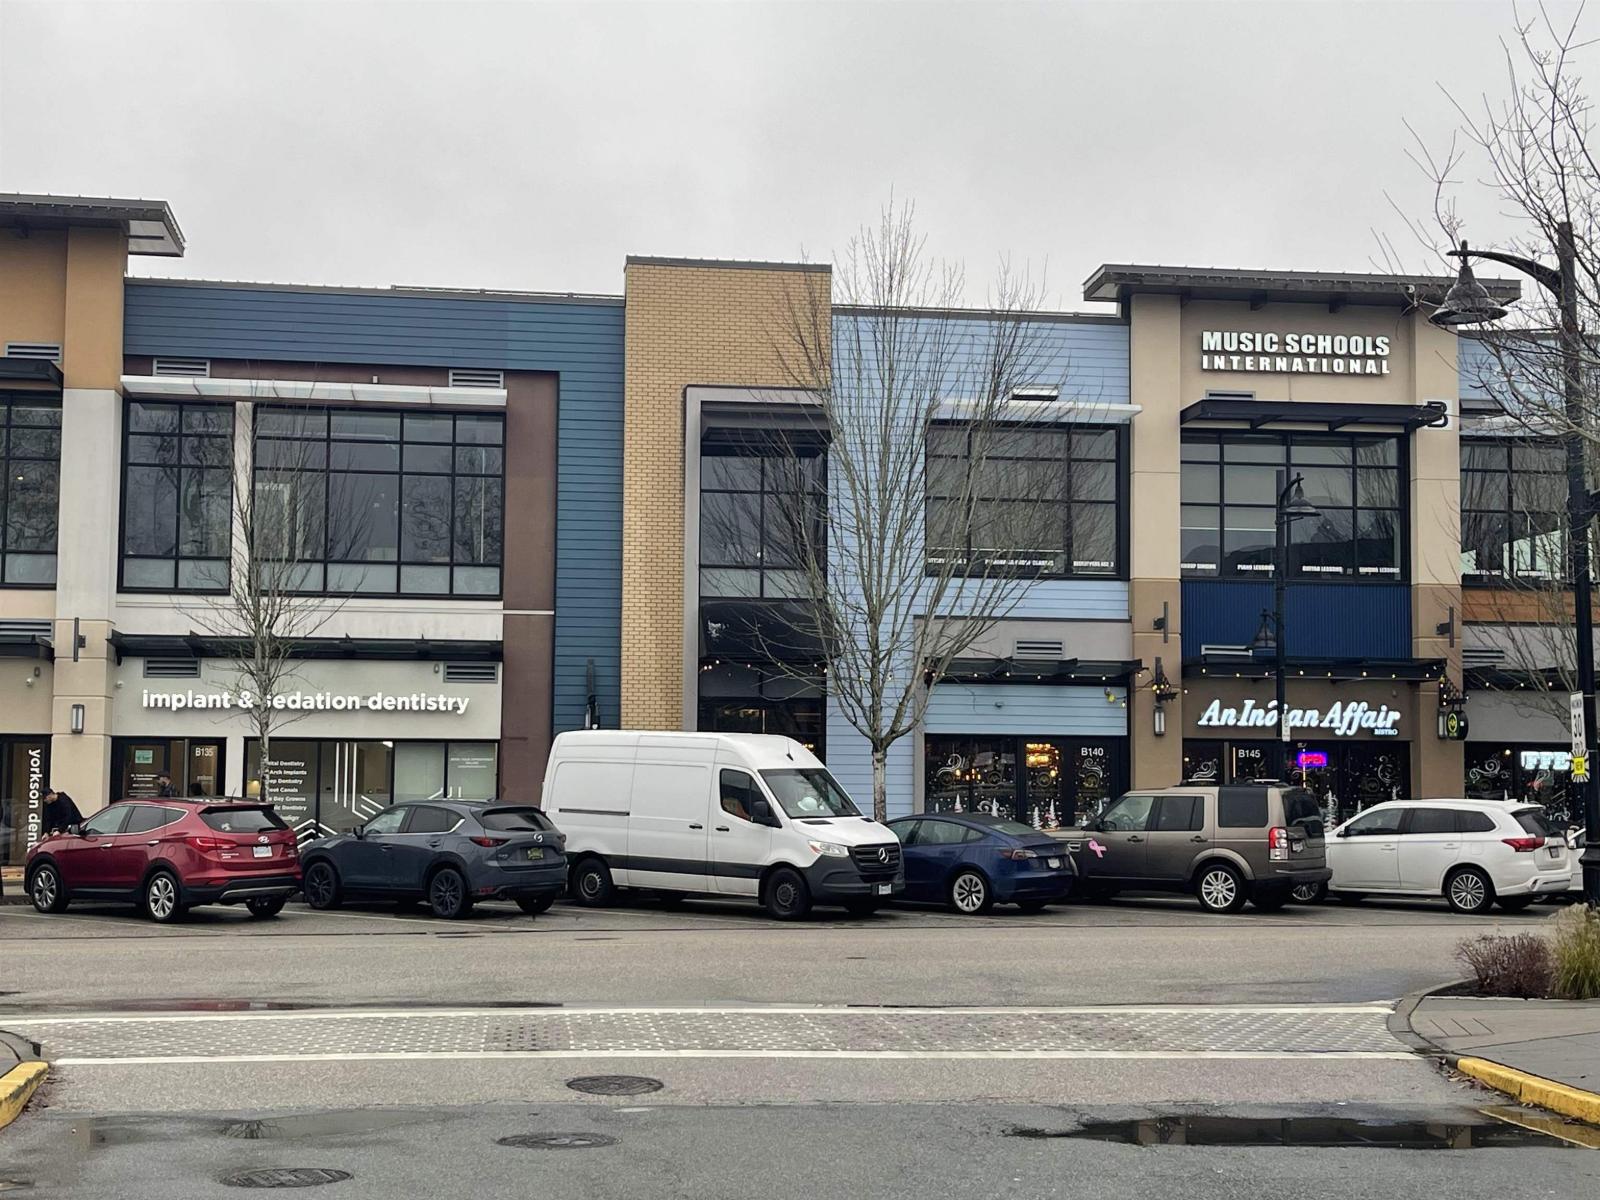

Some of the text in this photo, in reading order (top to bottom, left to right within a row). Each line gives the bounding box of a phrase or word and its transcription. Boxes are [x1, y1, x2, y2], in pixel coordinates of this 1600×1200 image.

[1202, 331, 1390, 356] MUSIC SCHOOLS
[1202, 354, 1390, 374] INTERNATIONAL
[142, 690, 231, 711] implant
[238, 691, 254, 708] &
[367, 692, 469, 714] dentistry
[1198, 700, 1237, 726] An
[1237, 700, 1319, 727] Indan
[1320, 701, 1401, 735] Affair
[195, 747, 214, 757] B135
[1081, 747, 1104, 757] B140
[1238, 750, 1261, 758] B145
[27, 749, 42, 853] yorkson dent
